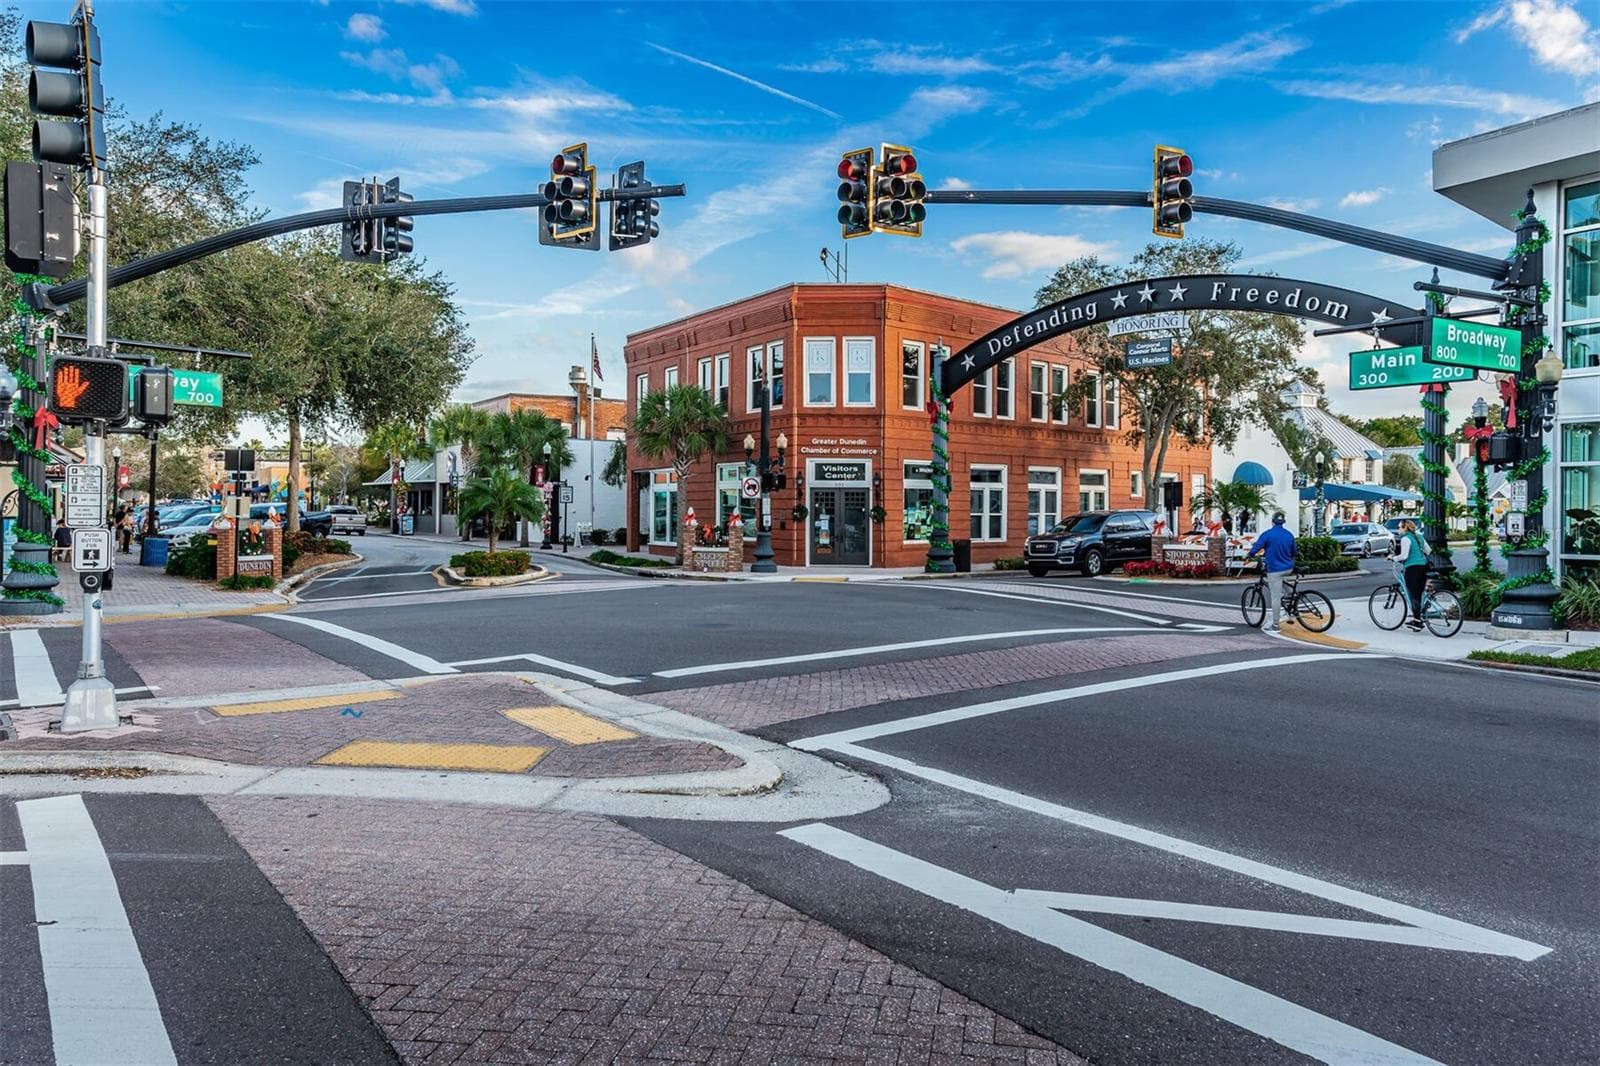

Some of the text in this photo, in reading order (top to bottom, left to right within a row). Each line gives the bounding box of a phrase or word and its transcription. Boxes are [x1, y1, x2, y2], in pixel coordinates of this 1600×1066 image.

[987, 281, 1350, 357] Defending Freedom
[1117, 316, 1179, 333] HONORING
[1447, 324, 1507, 352] Broadway
[1136, 342, 1161, 350] Corporal
[1142, 356, 1169, 364] Marines
[1371, 352, 1416, 369] Main
[1436, 345, 1516, 368] 800 700
[1359, 367, 1465, 385] 300 200
[187, 391, 214, 403] 700
[840, 447, 877, 455] Commerce
[1165, 550, 1207, 559] SHOPS ON
[239, 561, 272, 571] DUNEDIN
